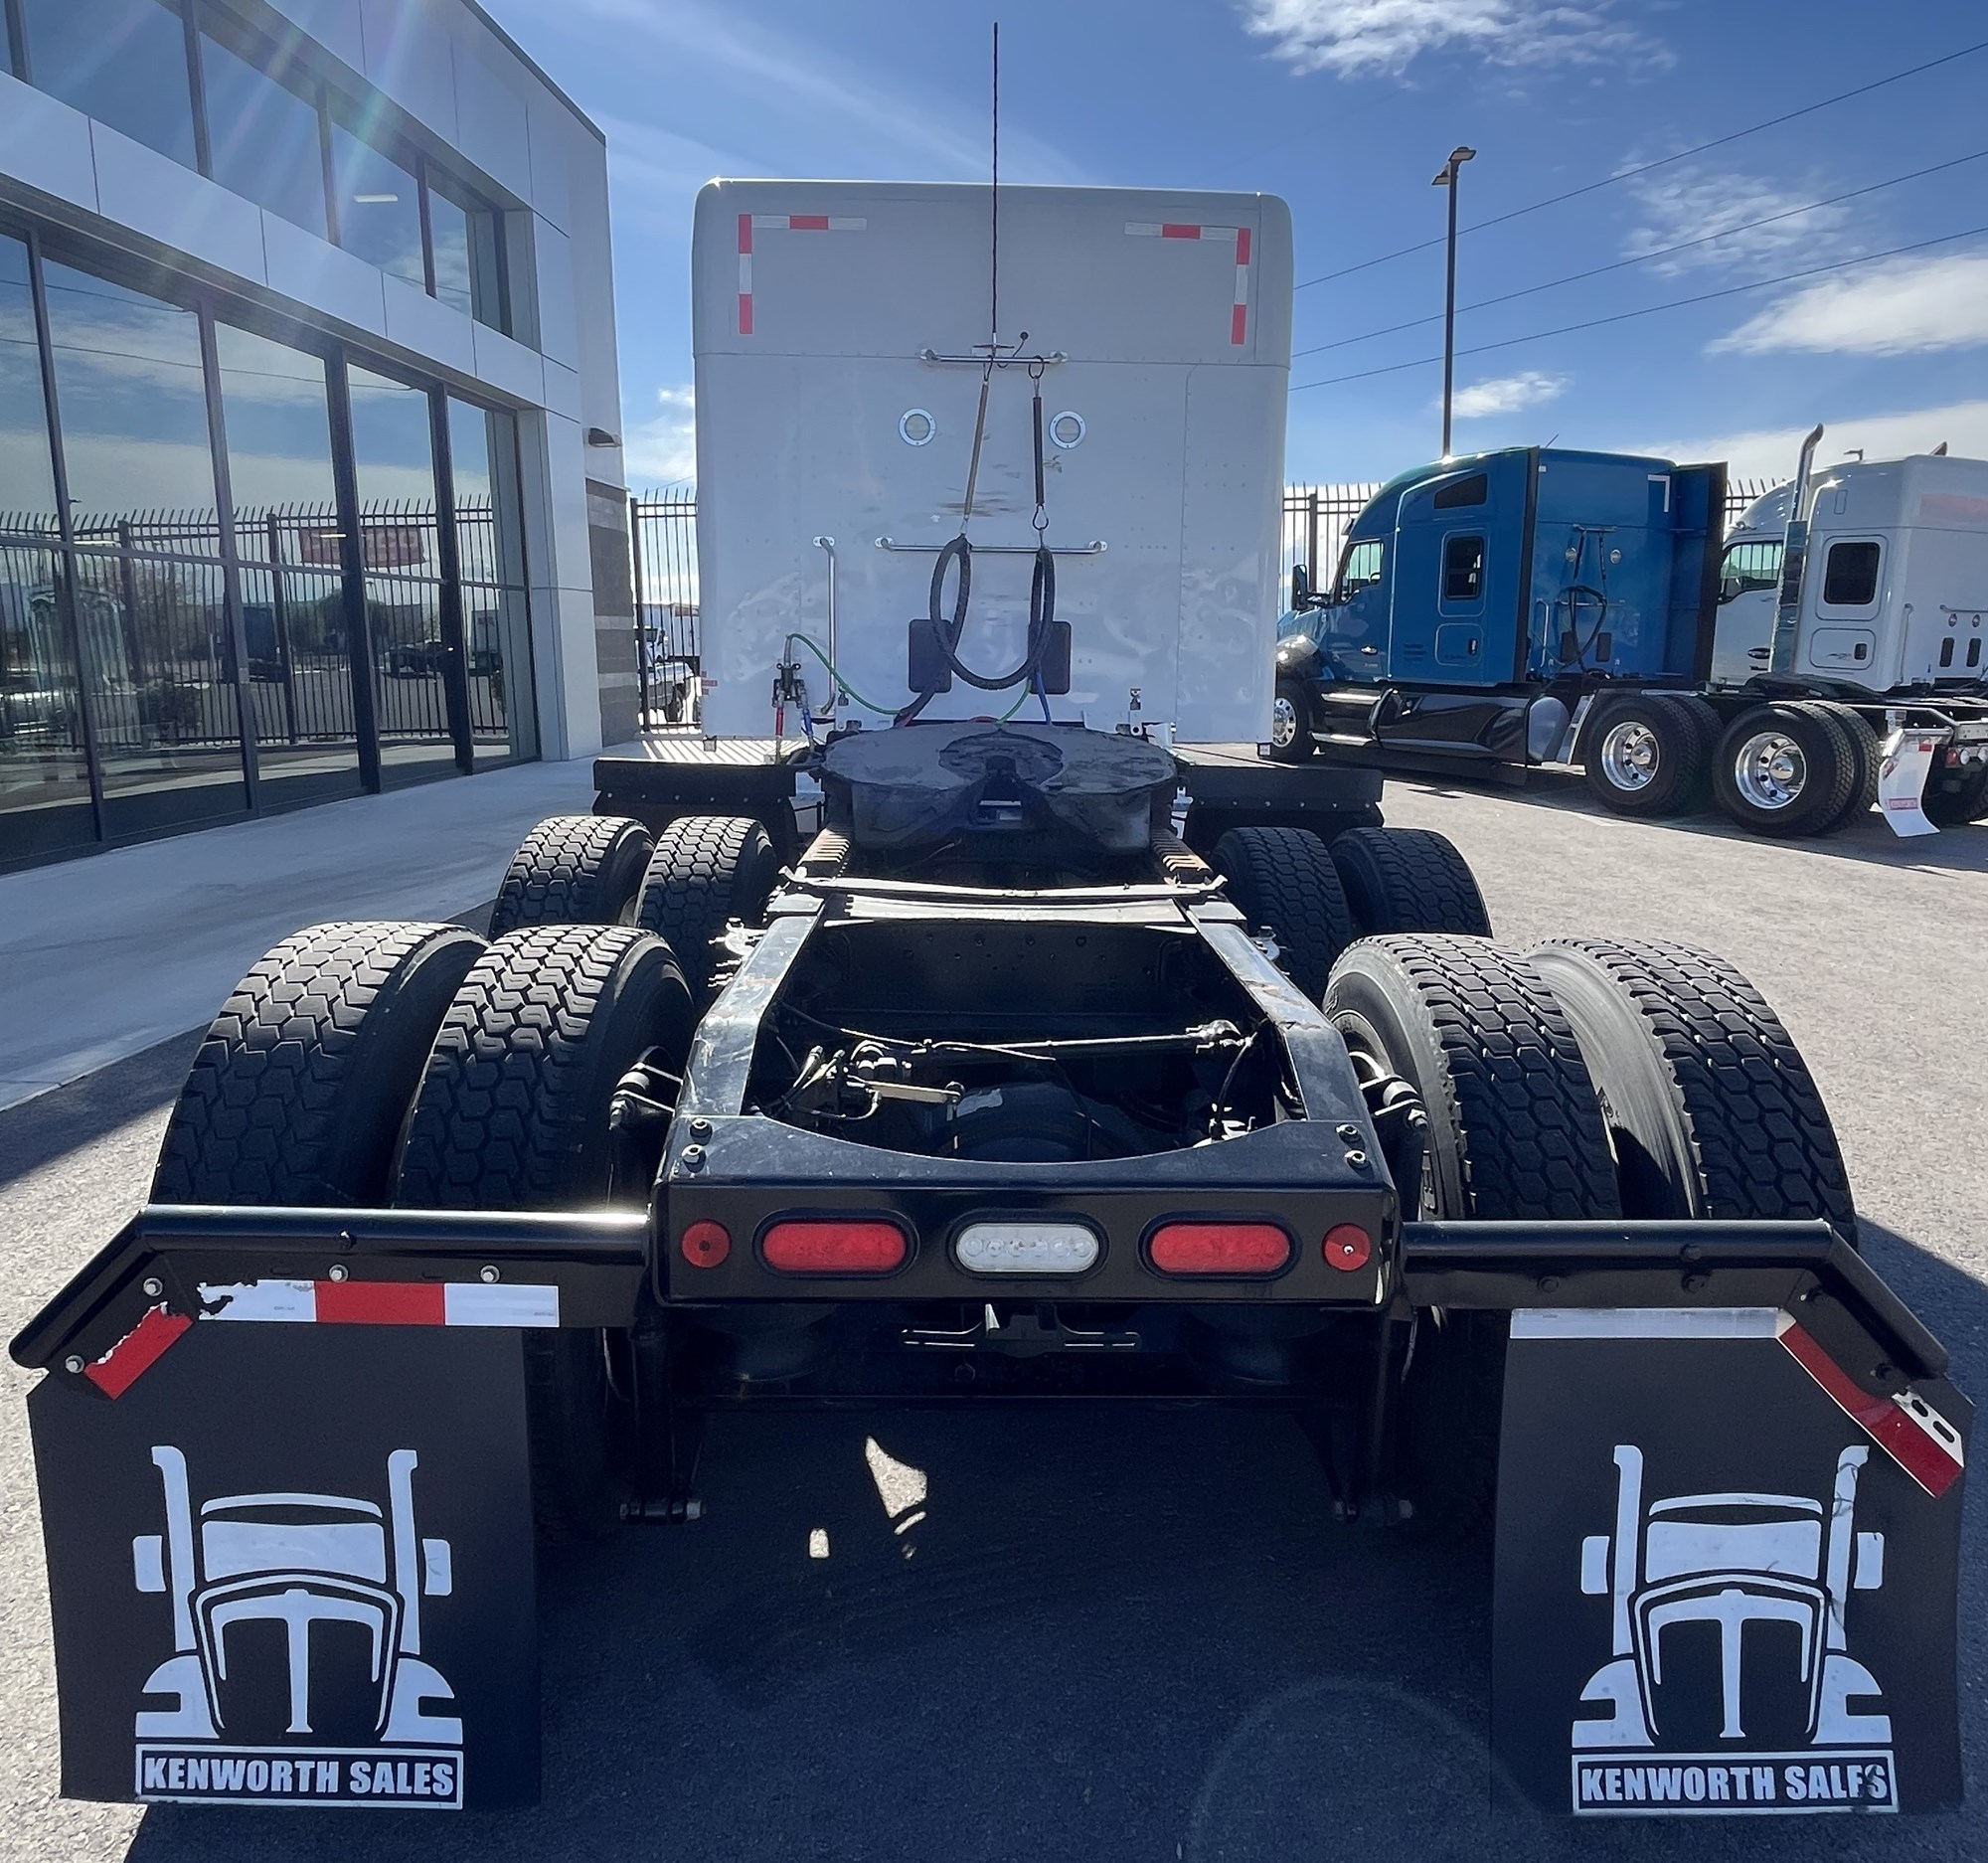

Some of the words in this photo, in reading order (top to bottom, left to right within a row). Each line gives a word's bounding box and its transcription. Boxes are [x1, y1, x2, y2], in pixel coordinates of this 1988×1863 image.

[144, 1757, 339, 1793] KENWORTH
[350, 1762, 453, 1796] SALES
[1581, 1767, 1776, 1801] KENWORTH
